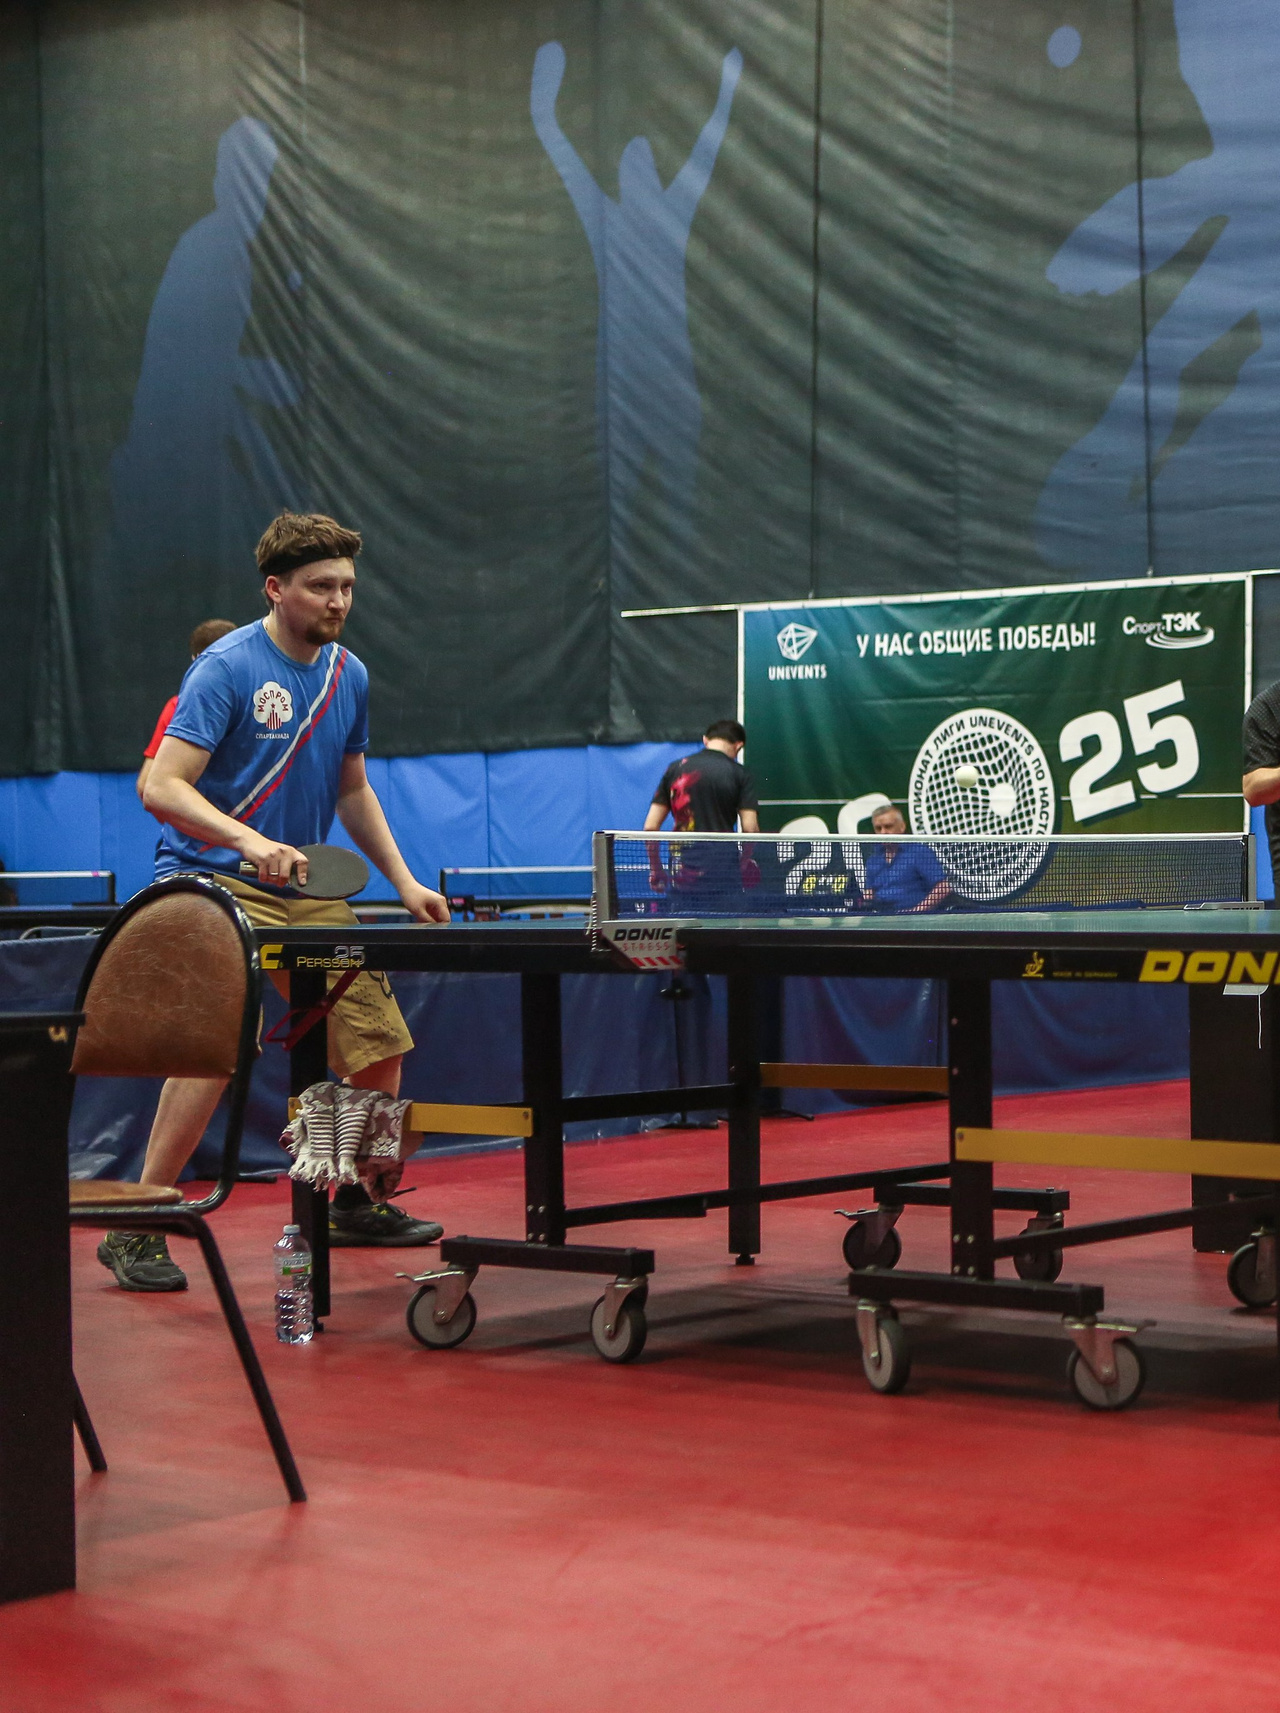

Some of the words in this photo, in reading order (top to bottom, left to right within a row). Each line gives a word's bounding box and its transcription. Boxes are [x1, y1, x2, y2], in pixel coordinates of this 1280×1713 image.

[856, 634, 869, 658] У
[874, 632, 914, 657] НАС
[919, 628, 993, 657] ОБЩИЕ
[998, 622, 1097, 652] ПОБЕДЫ!
[768, 664, 827, 681] UNEVENTS
[257, 690, 289, 713] МОСПРОМ
[1059, 679, 1200, 823] 25
[913, 750, 934, 835] МПИОНАТ
[933, 722, 966, 750] ЛИГИ
[969, 716, 1035, 756] UNEVENTS
[1032, 758, 1045, 781] ПО
[613, 928, 673, 941] DONIC
[623, 942, 670, 951] STRESS
